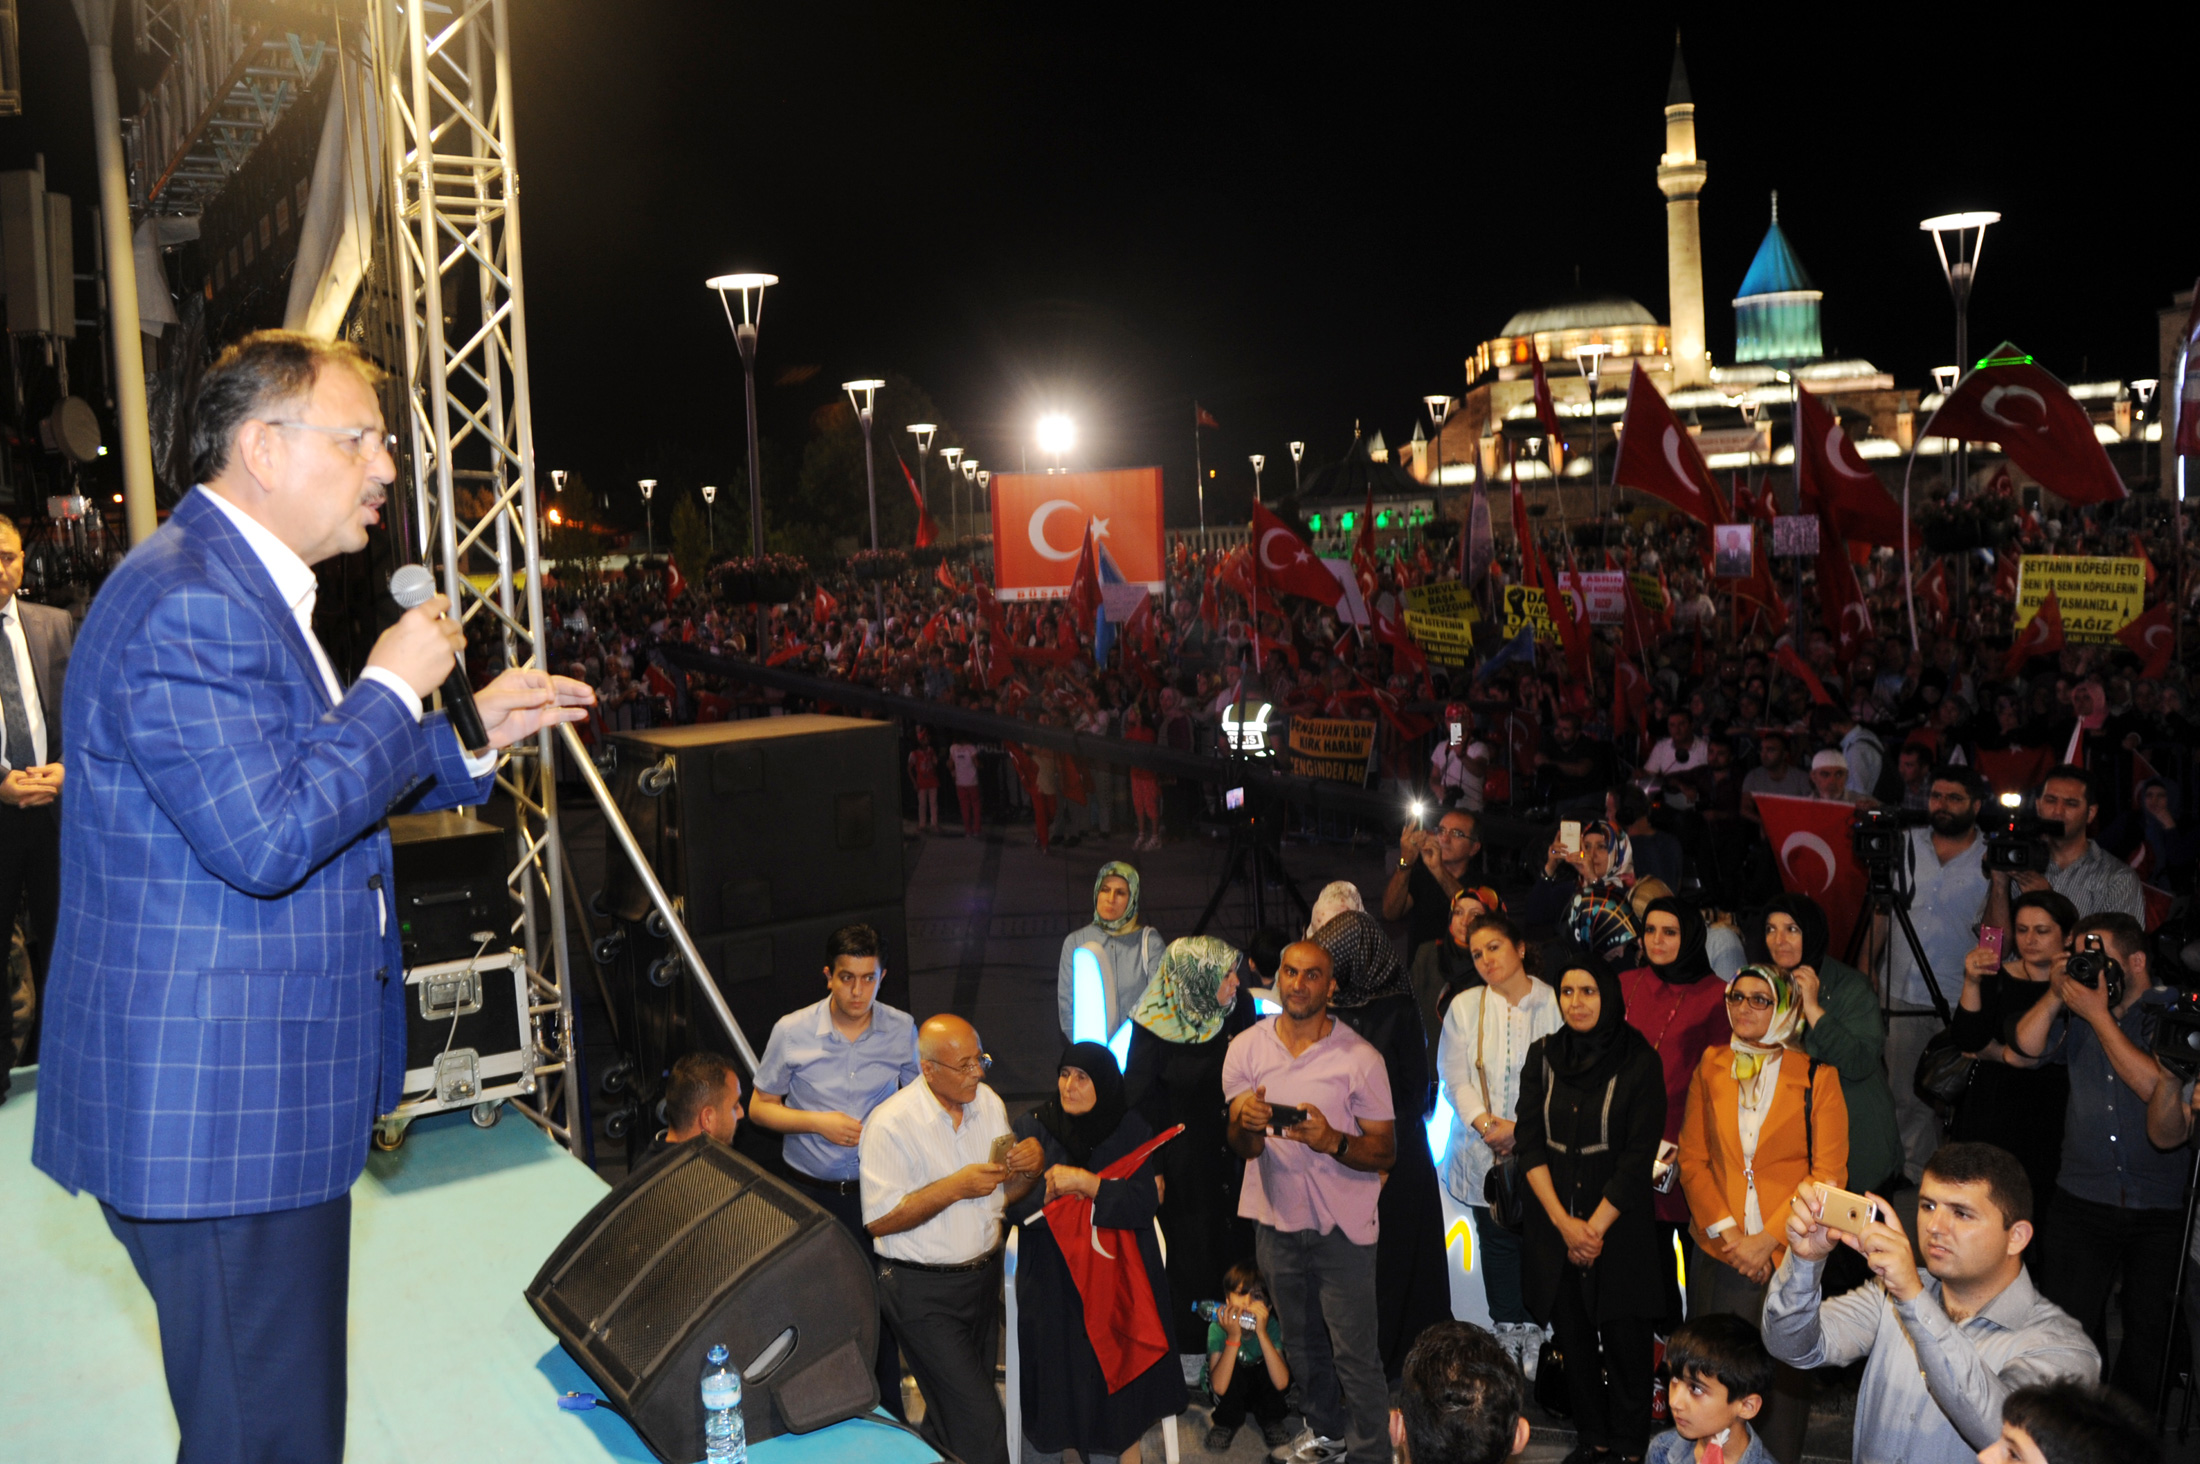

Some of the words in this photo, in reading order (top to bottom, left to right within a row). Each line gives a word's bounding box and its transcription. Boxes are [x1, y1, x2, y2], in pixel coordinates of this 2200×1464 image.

[2024, 560, 2072, 574] ŞEYTANIN
[1586, 575, 1622, 583] ASRIN
[1411, 588, 1425, 598] YA
[1428, 583, 1463, 595] DEVLE
[1428, 594, 1456, 605] BAŞA
[1430, 601, 1475, 615] KUZGUN
[2062, 615, 2113, 631] CAĞIZ
[1227, 735, 1257, 745] PIS
[1299, 736, 1321, 752] KIRK
